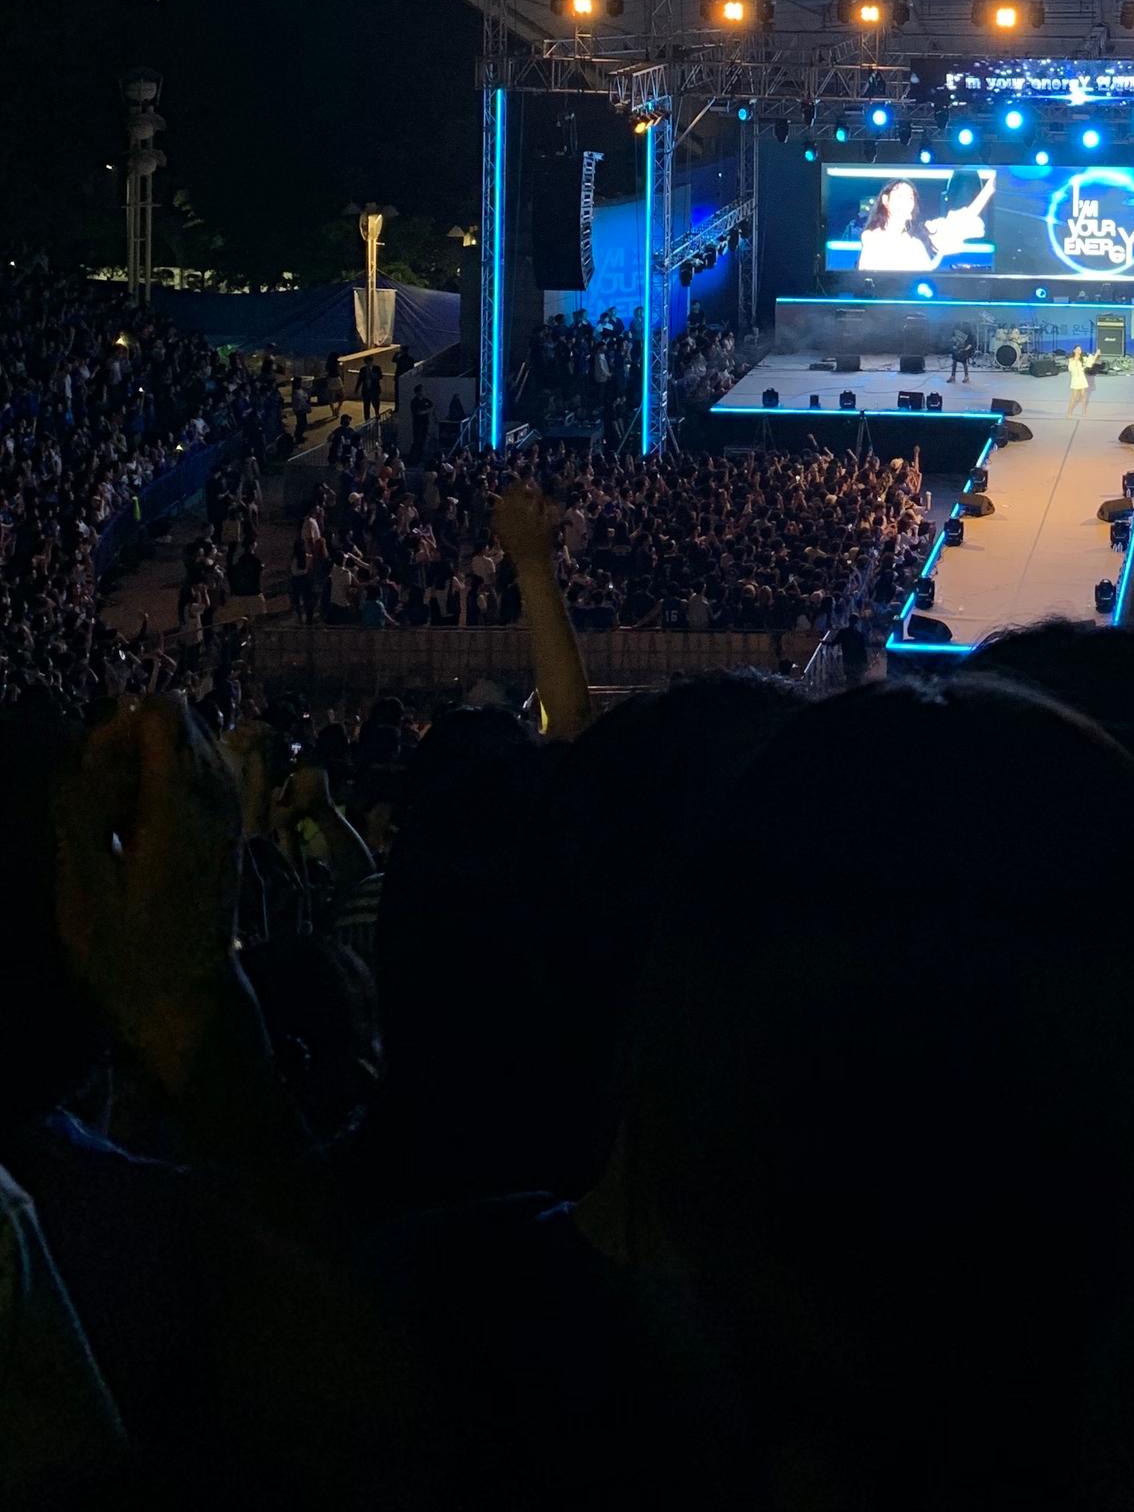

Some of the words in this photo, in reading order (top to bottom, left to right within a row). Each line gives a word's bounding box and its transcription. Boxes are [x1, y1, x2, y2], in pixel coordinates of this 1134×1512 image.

[986, 78, 1026, 91] your
[1072, 180, 1099, 218] I'M
[1067, 219, 1116, 241] YOUR
